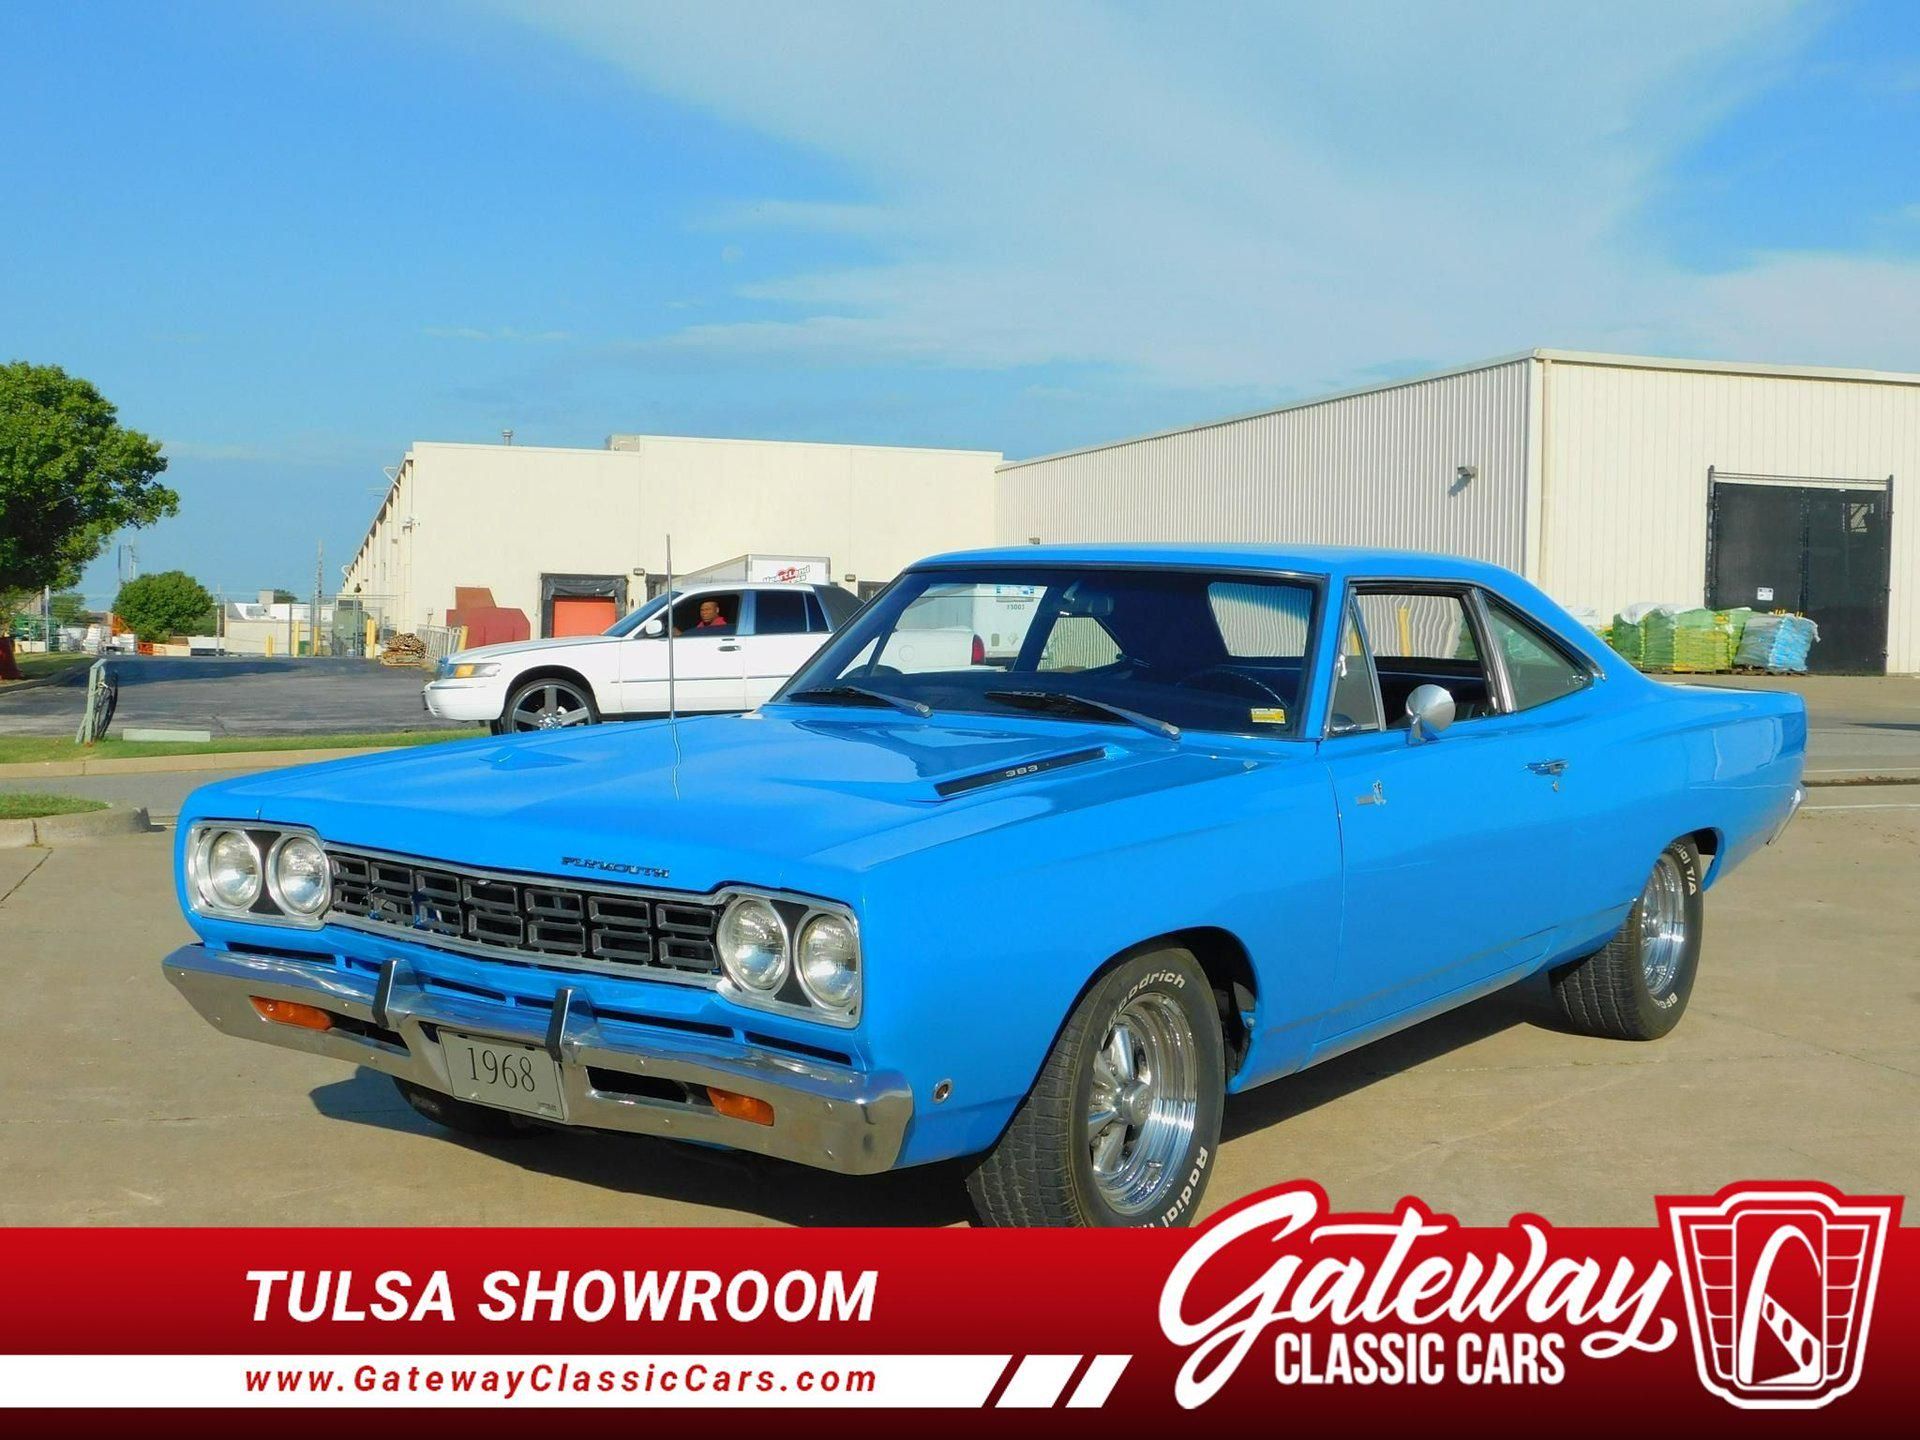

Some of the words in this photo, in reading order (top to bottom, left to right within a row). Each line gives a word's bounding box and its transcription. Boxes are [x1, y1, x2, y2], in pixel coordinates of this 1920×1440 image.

[1006, 765, 1038, 777] 383
[561, 856, 670, 878] PLYMOUTH
[467, 1047, 536, 1092] 1968
[1161, 1146, 1209, 1228] Radial
